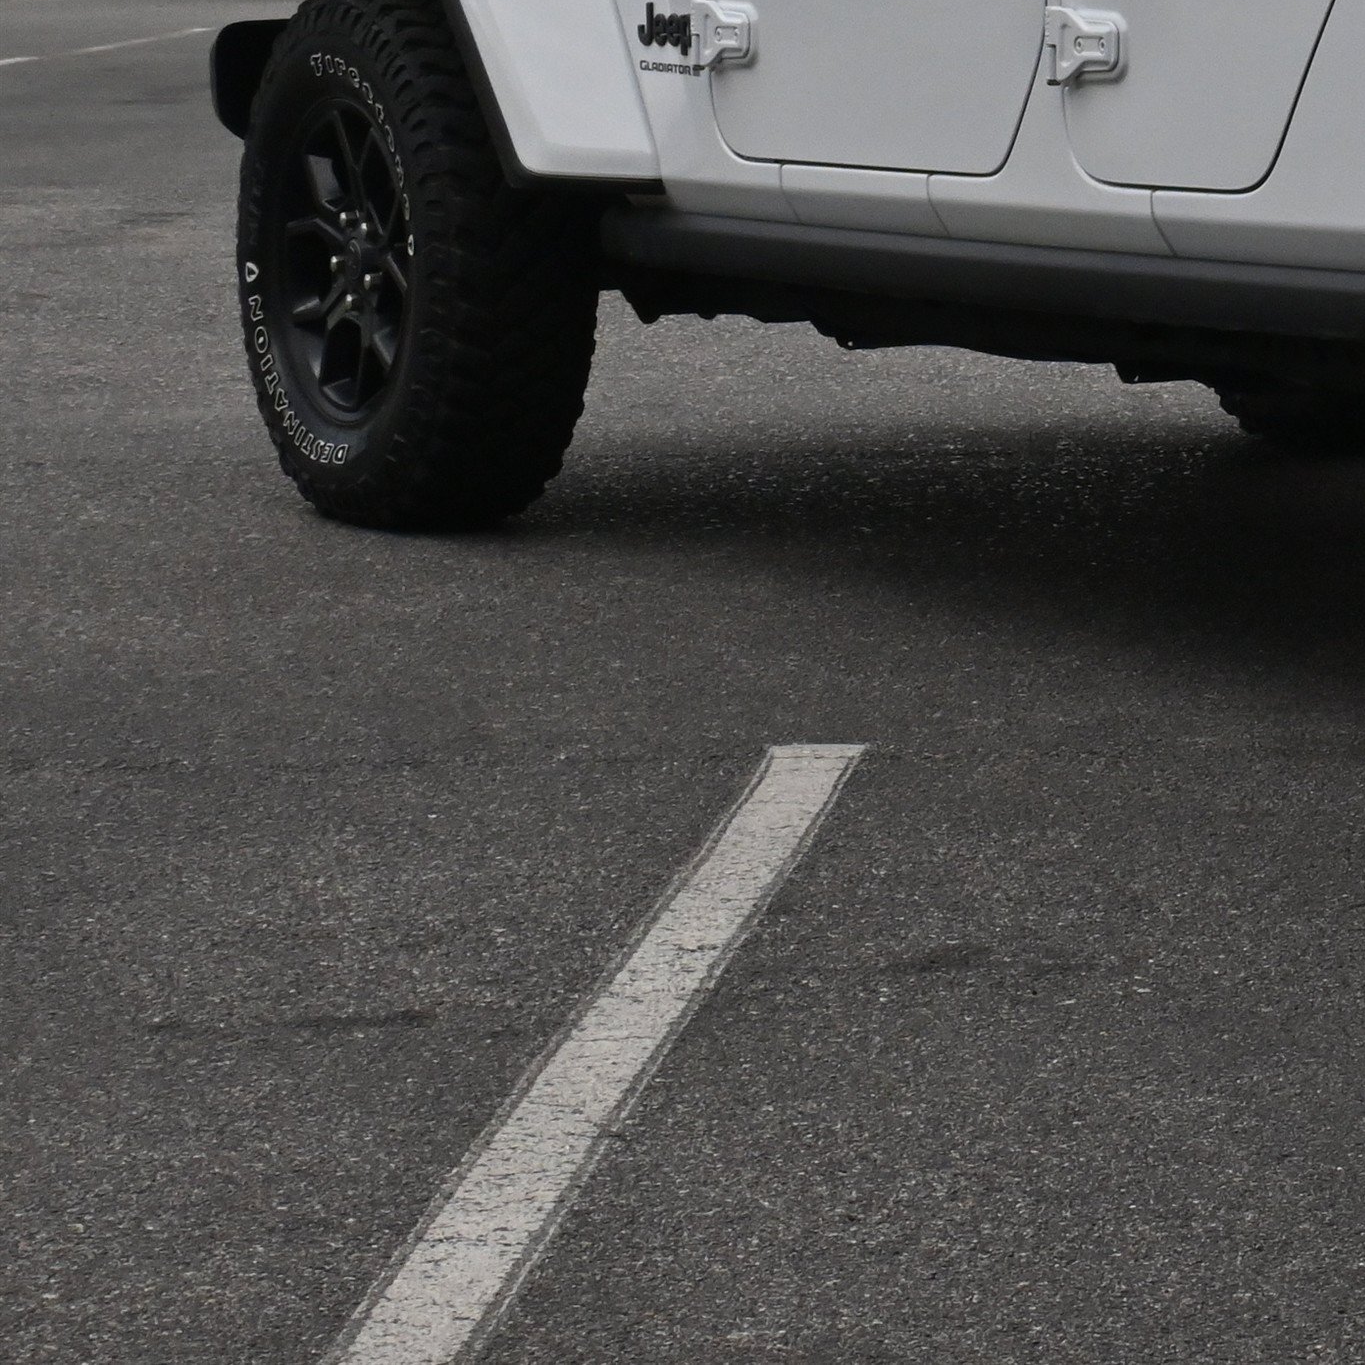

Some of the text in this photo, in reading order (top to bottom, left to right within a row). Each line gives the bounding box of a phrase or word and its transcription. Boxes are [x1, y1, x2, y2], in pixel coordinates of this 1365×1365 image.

[637, 1, 693, 56] Jeep
[640, 60, 692, 76] GLADIATOR
[248, 294, 348, 466] DESTINATION
